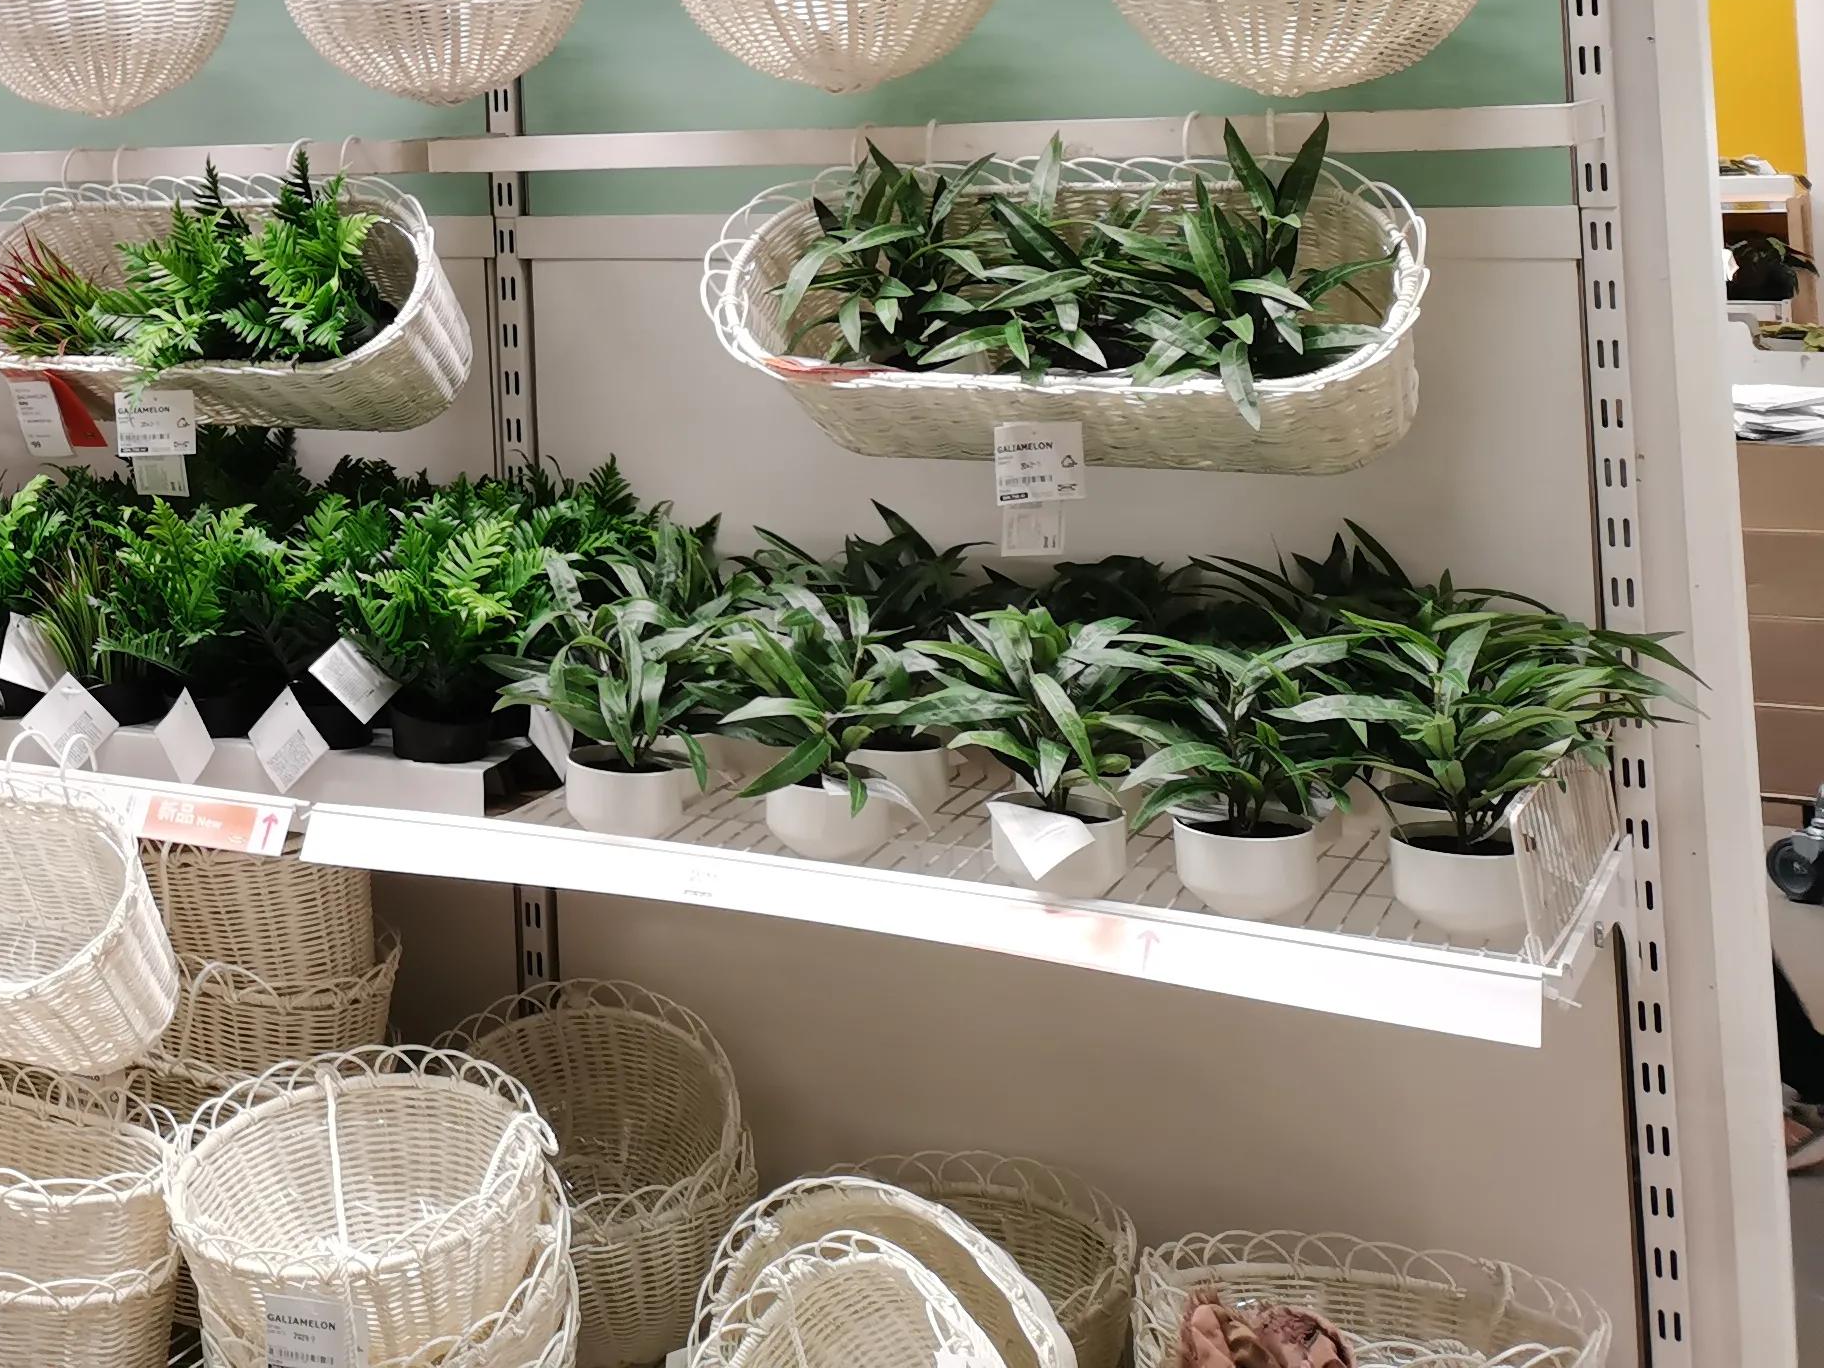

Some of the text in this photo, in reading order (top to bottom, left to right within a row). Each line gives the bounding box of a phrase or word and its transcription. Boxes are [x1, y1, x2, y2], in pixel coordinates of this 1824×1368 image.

[157, 799, 224, 831] 新品 New
[267, 1313, 336, 1331] GALIAMELON
